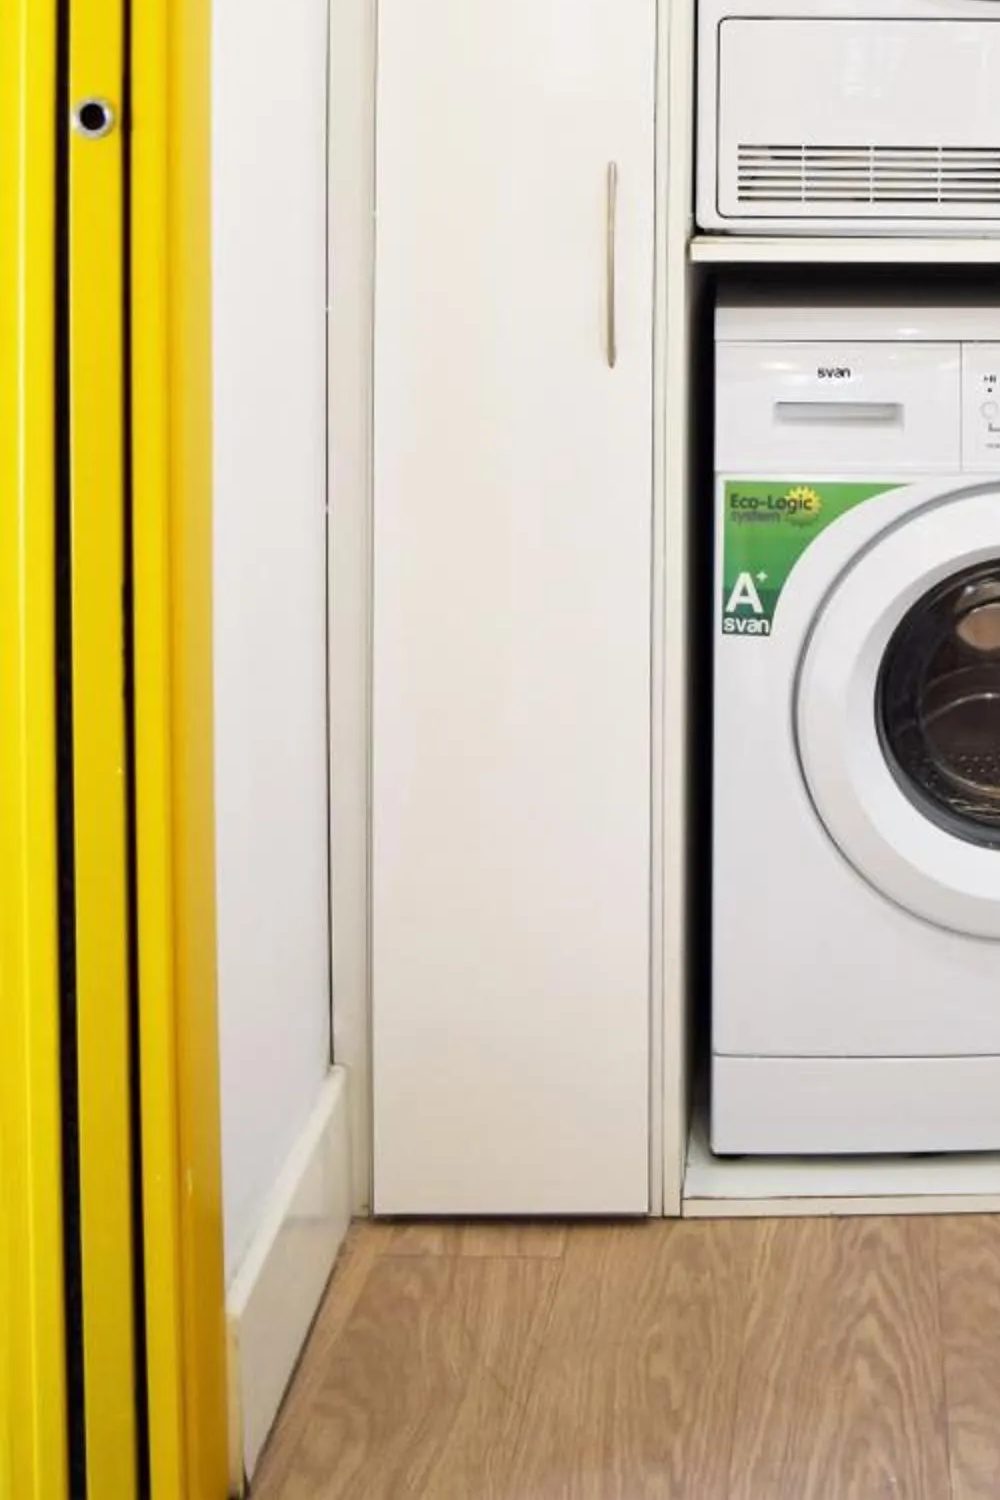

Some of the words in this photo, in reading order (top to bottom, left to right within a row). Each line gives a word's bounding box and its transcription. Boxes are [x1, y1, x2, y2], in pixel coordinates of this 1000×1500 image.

[817, 367, 851, 379] svan
[730, 493, 813, 514] Eco-Logic
[723, 617, 770, 634] svan
